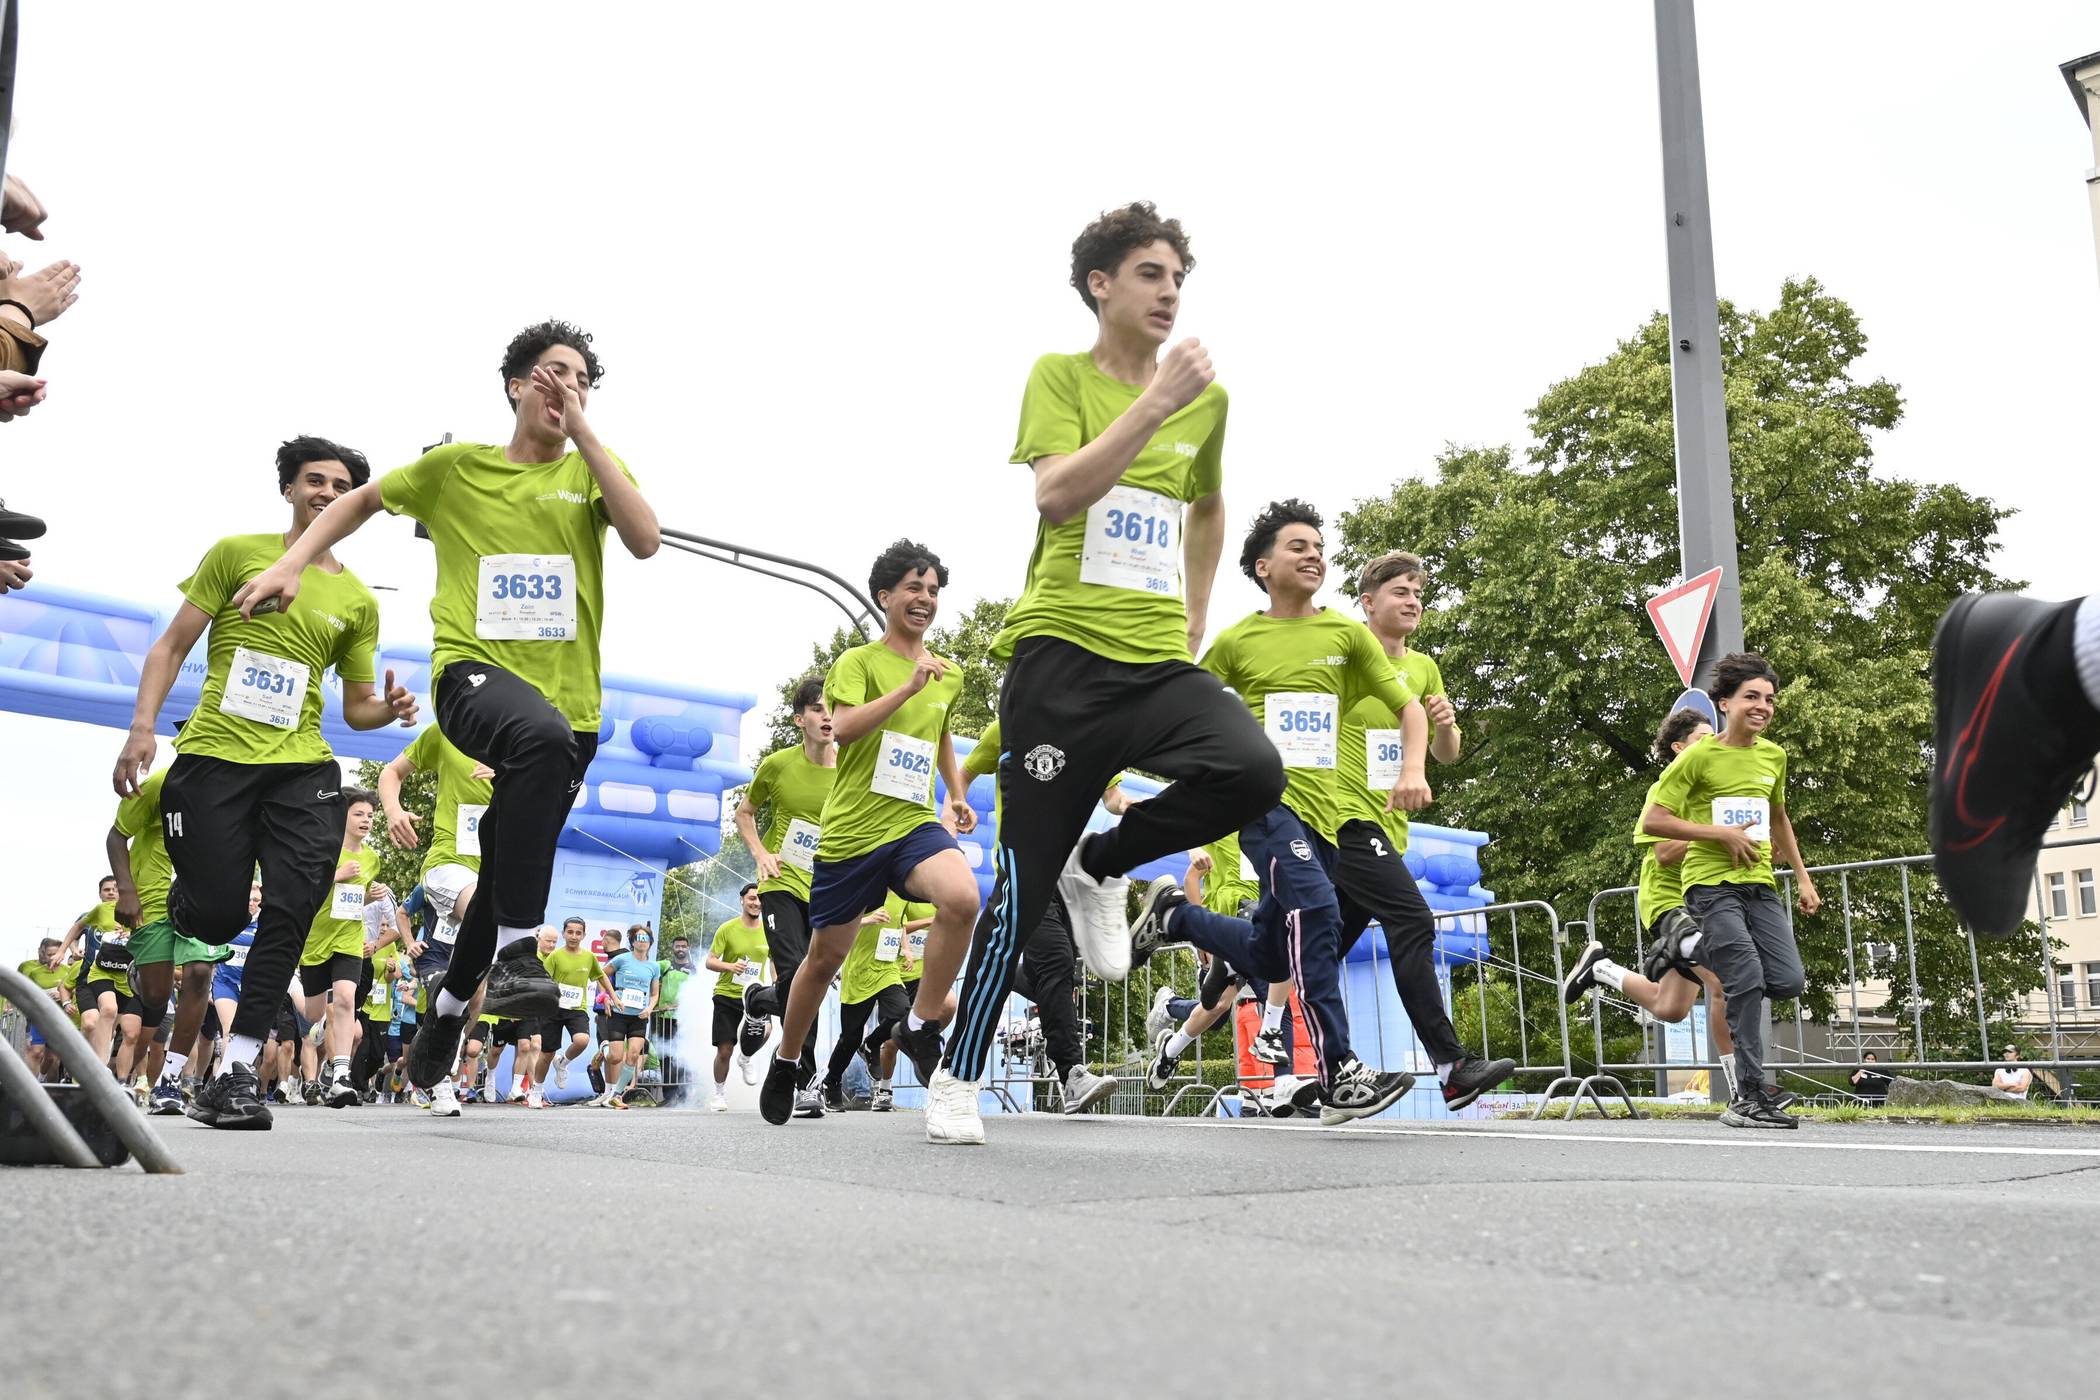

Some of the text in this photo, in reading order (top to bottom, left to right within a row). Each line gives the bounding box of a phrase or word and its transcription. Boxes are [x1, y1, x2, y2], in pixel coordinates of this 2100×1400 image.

[1104, 508, 1169, 549] 3618
[492, 574, 562, 600] 3633
[1145, 576, 1169, 592] 3618
[538, 626, 566, 638] 3633
[241, 666, 295, 697] 3631
[269, 714, 290, 726] 3631
[1279, 710, 1332, 733] 3654
[1377, 743, 1404, 762] 361
[889, 748, 931, 775] 3625
[911, 792, 926, 803] 3625
[166, 811, 183, 838] 14
[1723, 809, 1762, 825] 3653
[793, 831, 820, 851] 362
[1369, 837, 1389, 857] 2
[340, 891, 363, 904] 3639
[883, 936, 901, 947] 363
[100, 960, 128, 970] adidas
[744, 966, 759, 977] 656
[560, 989, 580, 1000] 3627
